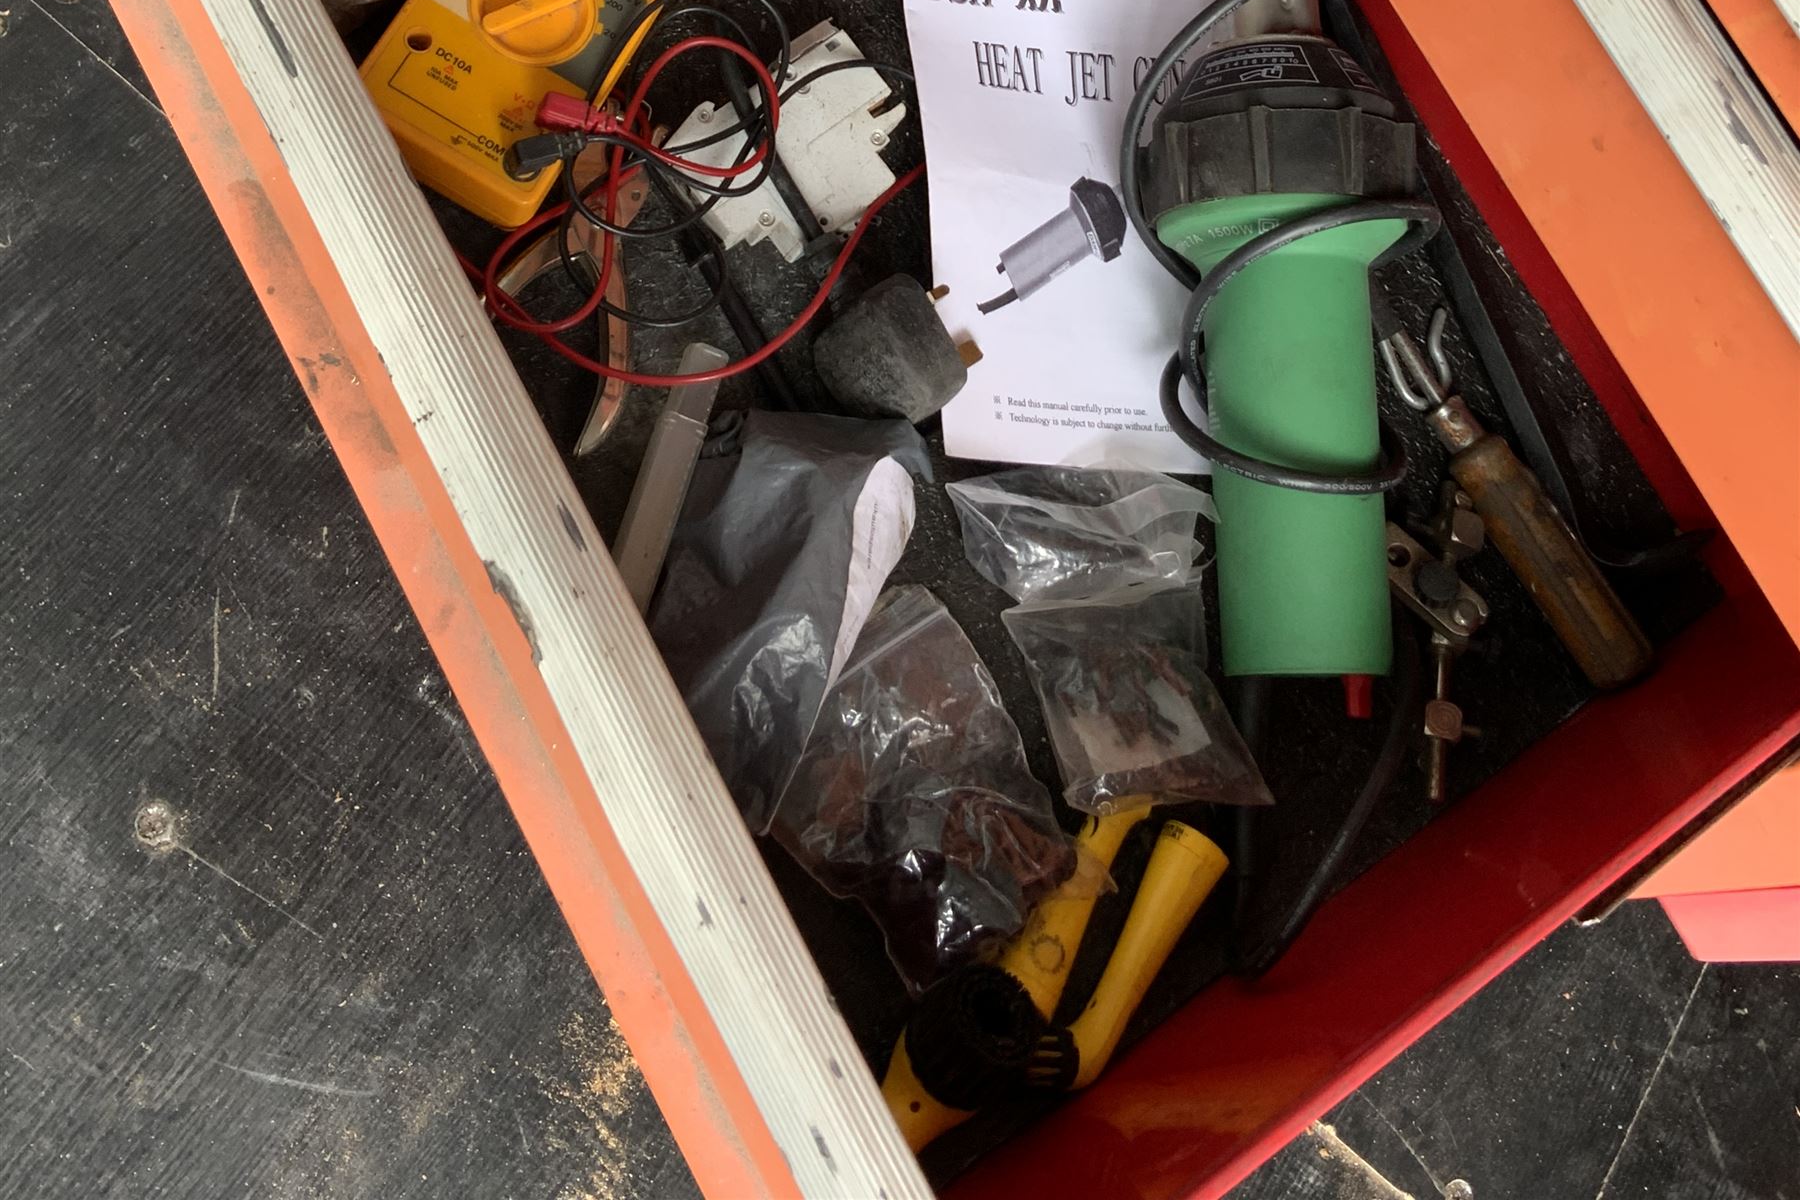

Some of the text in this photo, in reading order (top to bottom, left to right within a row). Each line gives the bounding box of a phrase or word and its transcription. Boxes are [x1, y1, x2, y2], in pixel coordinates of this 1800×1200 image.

[972, 41, 1044, 94] HEAT
[1064, 50, 1117, 107] JET
[477, 135, 506, 156] COM
[1207, 224, 1252, 240] 1500W
[1007, 397, 1148, 417] Read this manual carefully prior to use.
[1009, 412, 1051, 426] Technology
[1052, 417, 1060, 426] is
[1060, 418, 1086, 430] subject
[1087, 420, 1096, 429] to
[1097, 421, 1123, 431] change
[1124, 422, 1152, 432] without
